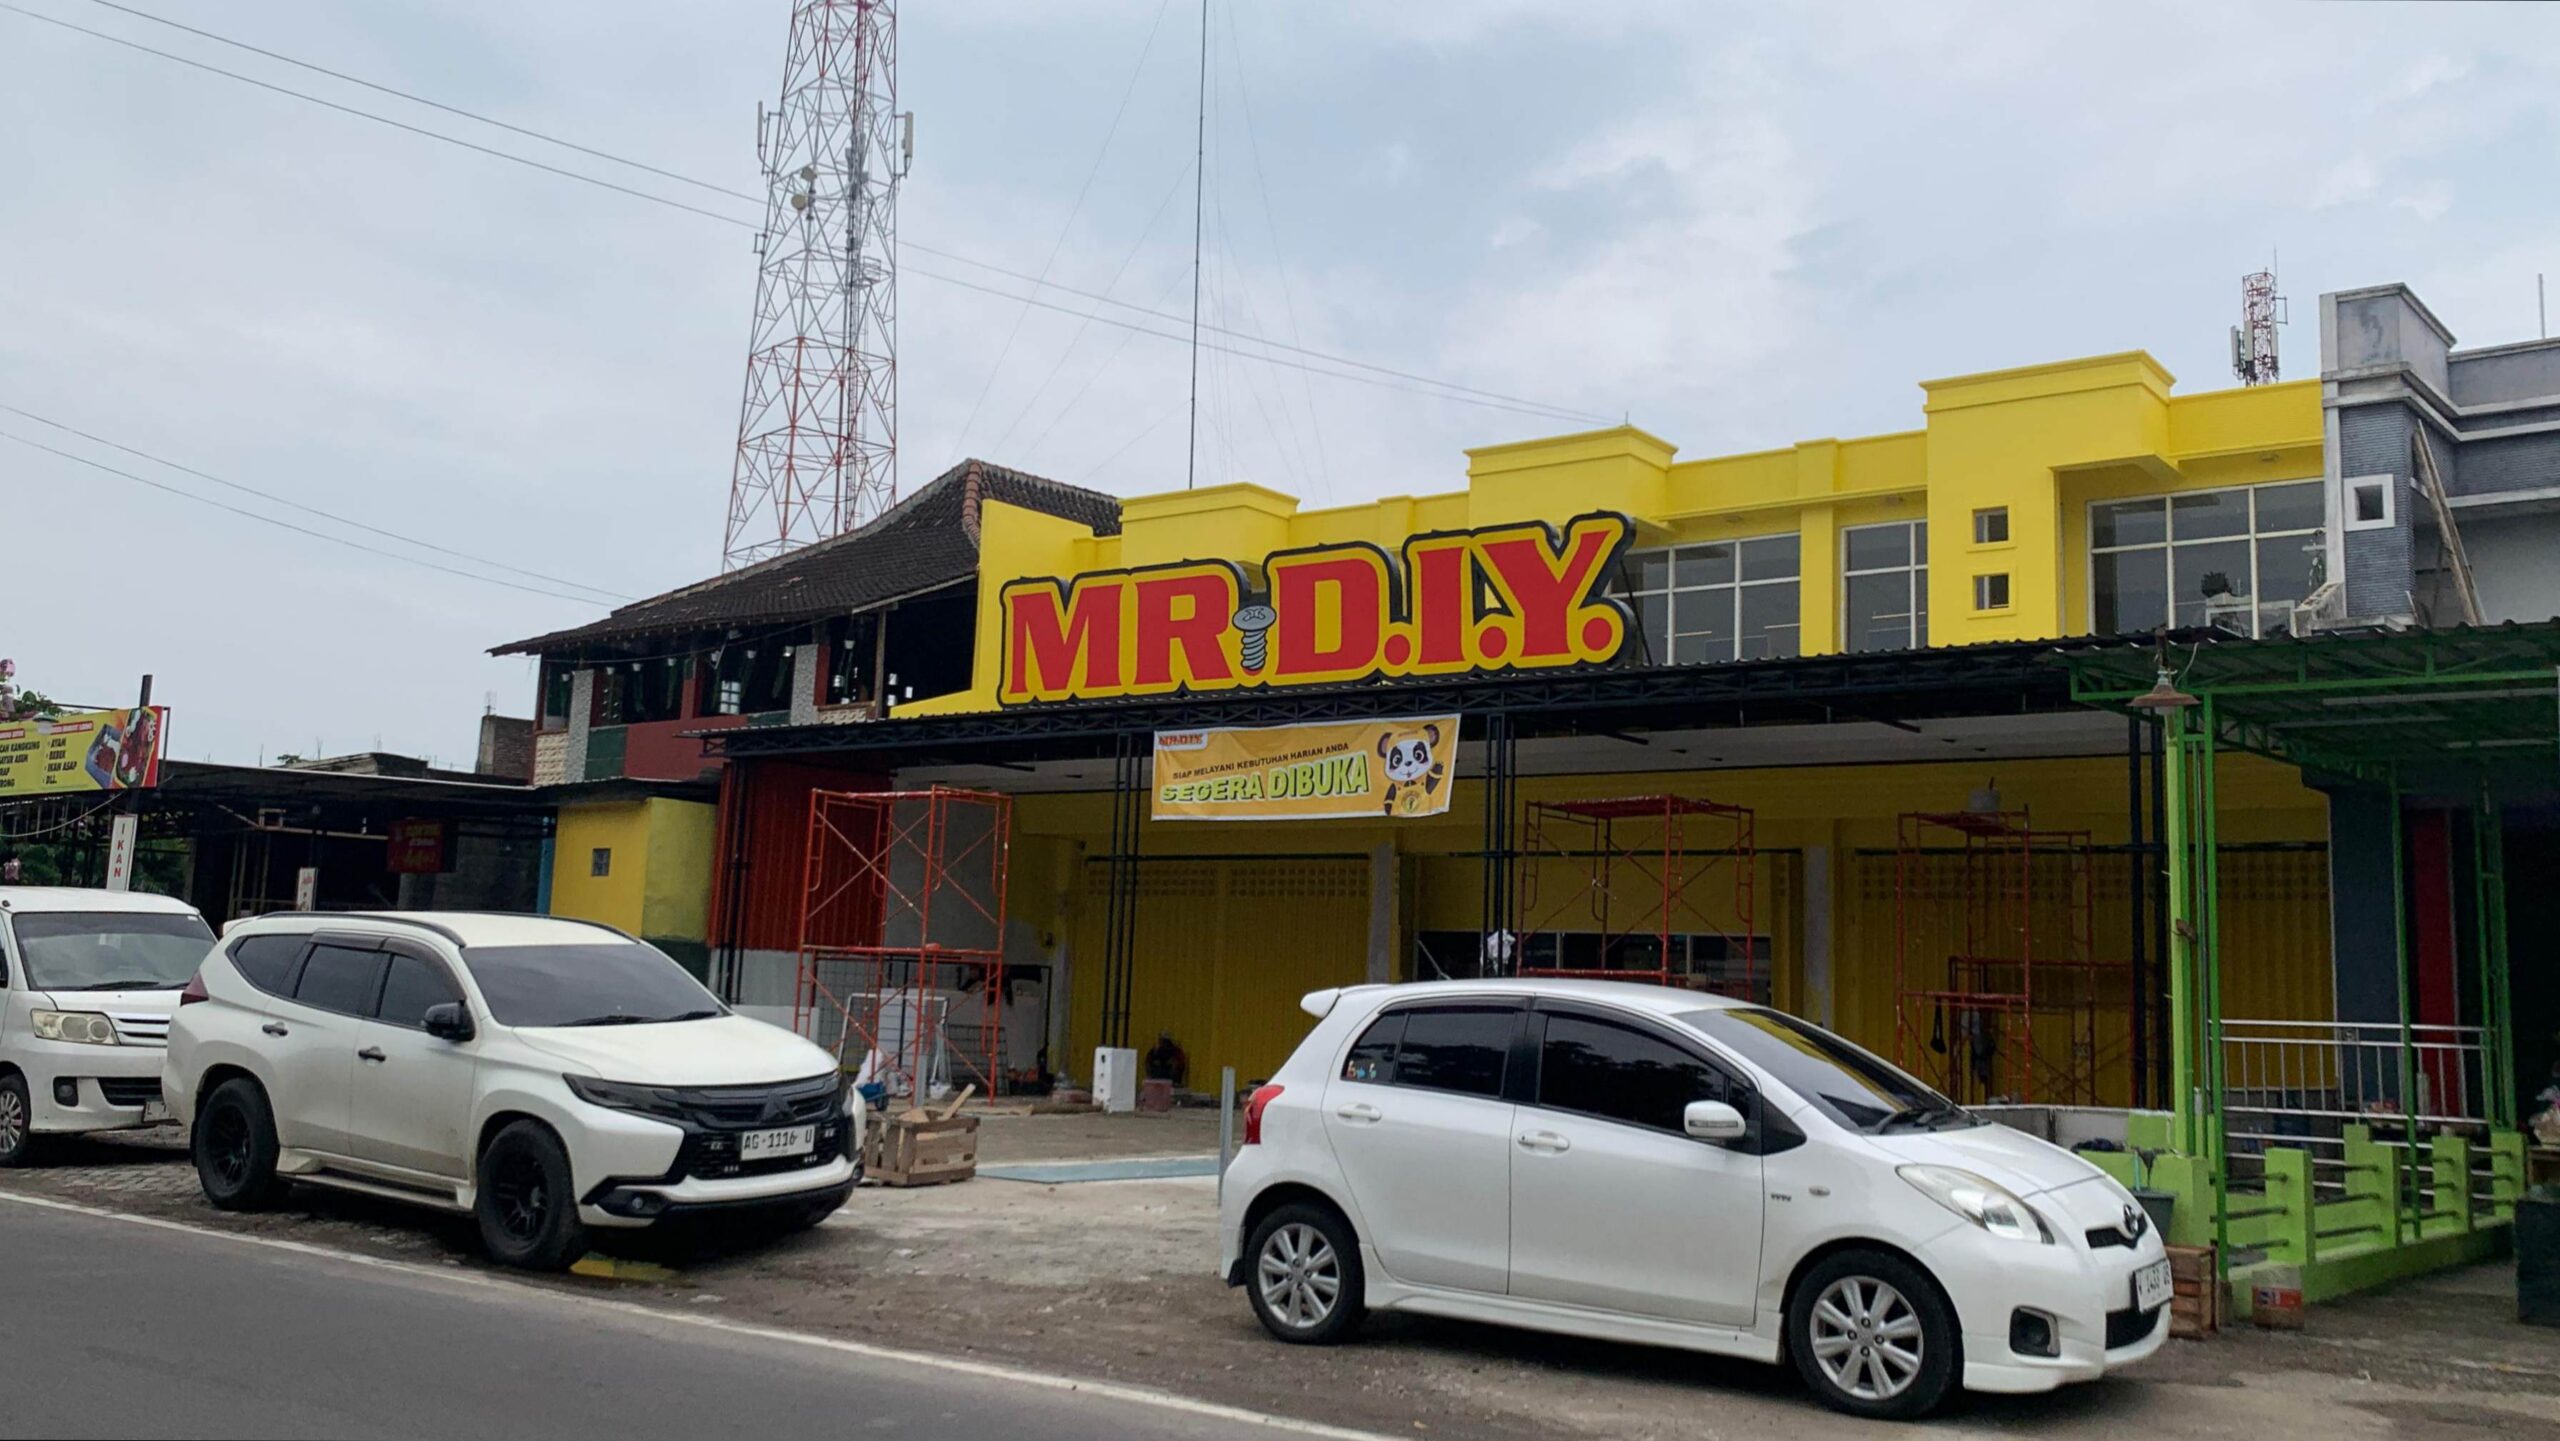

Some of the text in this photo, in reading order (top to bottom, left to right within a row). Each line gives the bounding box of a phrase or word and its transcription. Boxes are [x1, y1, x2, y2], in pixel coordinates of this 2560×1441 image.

[1162, 753, 1370, 801] SEGERA DIBUKA
[1173, 742, 1350, 780] SIAP MELAYANI KEBUTUHAN HARIAN ANDA
[113, 823, 126, 878] IKAN
[744, 1133, 760, 1151] AG
[804, 1128, 813, 1144] U
